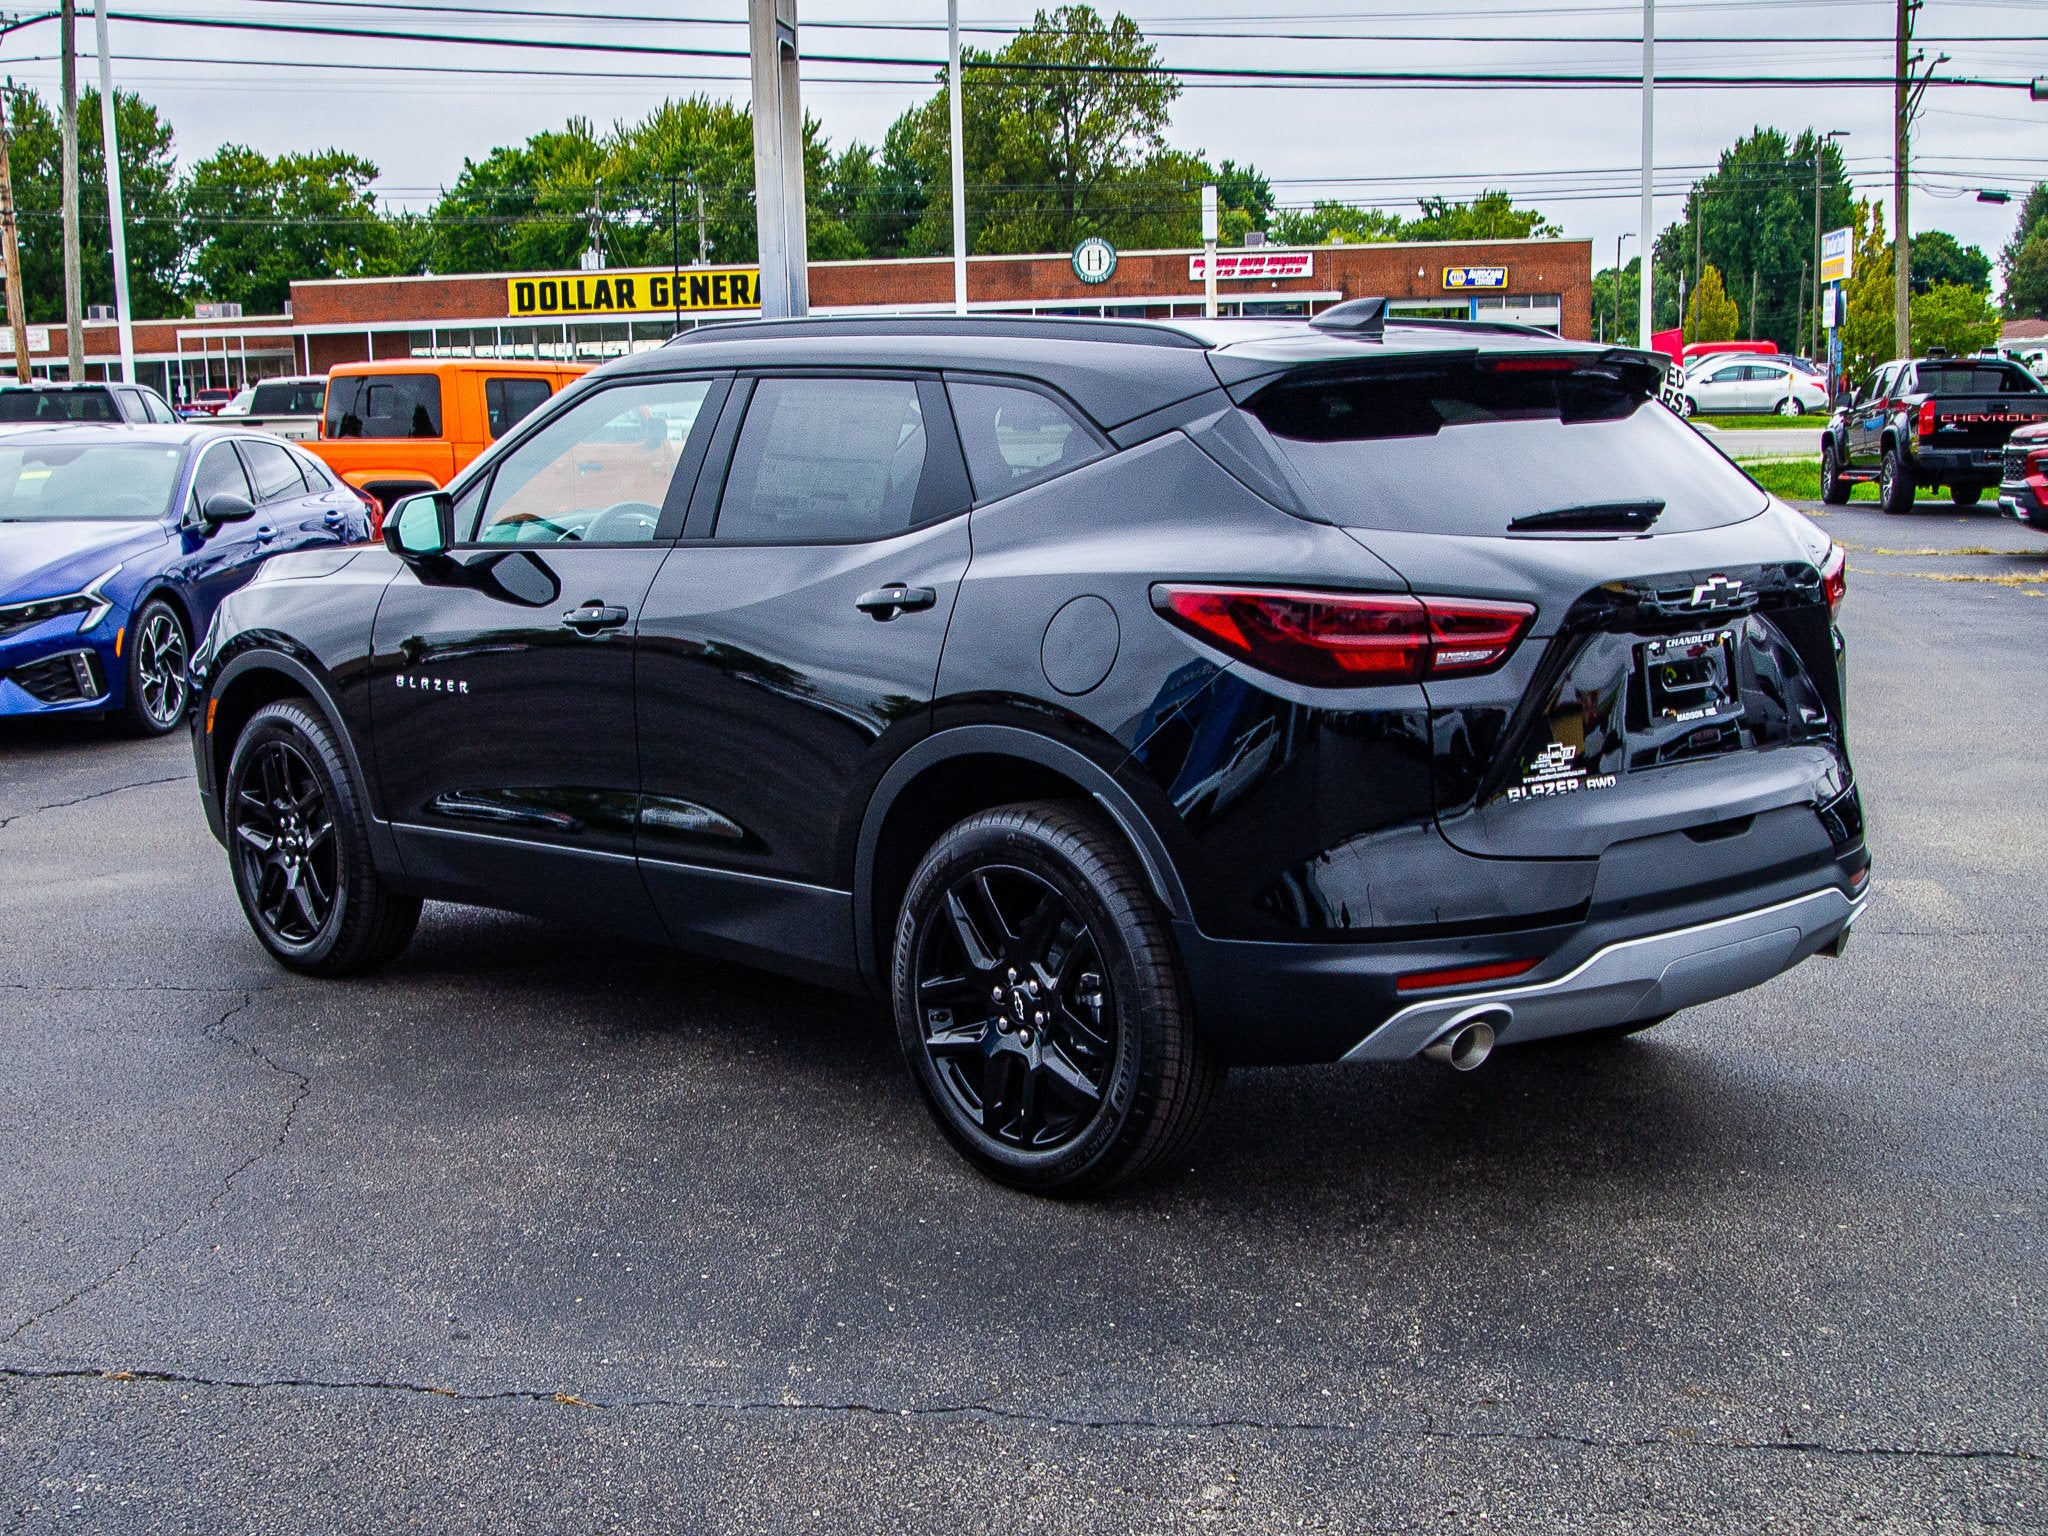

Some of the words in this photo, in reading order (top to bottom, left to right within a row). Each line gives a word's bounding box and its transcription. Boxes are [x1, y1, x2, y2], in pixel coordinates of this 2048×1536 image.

[515, 278, 637, 312] DOLLAR
[650, 274, 761, 307] GENER
[1666, 366, 1685, 390] ED
[1662, 388, 1684, 413] RS
[1940, 413, 2048, 422] CHEVROLE
[1666, 632, 1716, 648] CHANDLER
[396, 674, 469, 694] BLAZER
[1507, 778, 1579, 803] BLAZER
[1586, 774, 1617, 790] AWD
